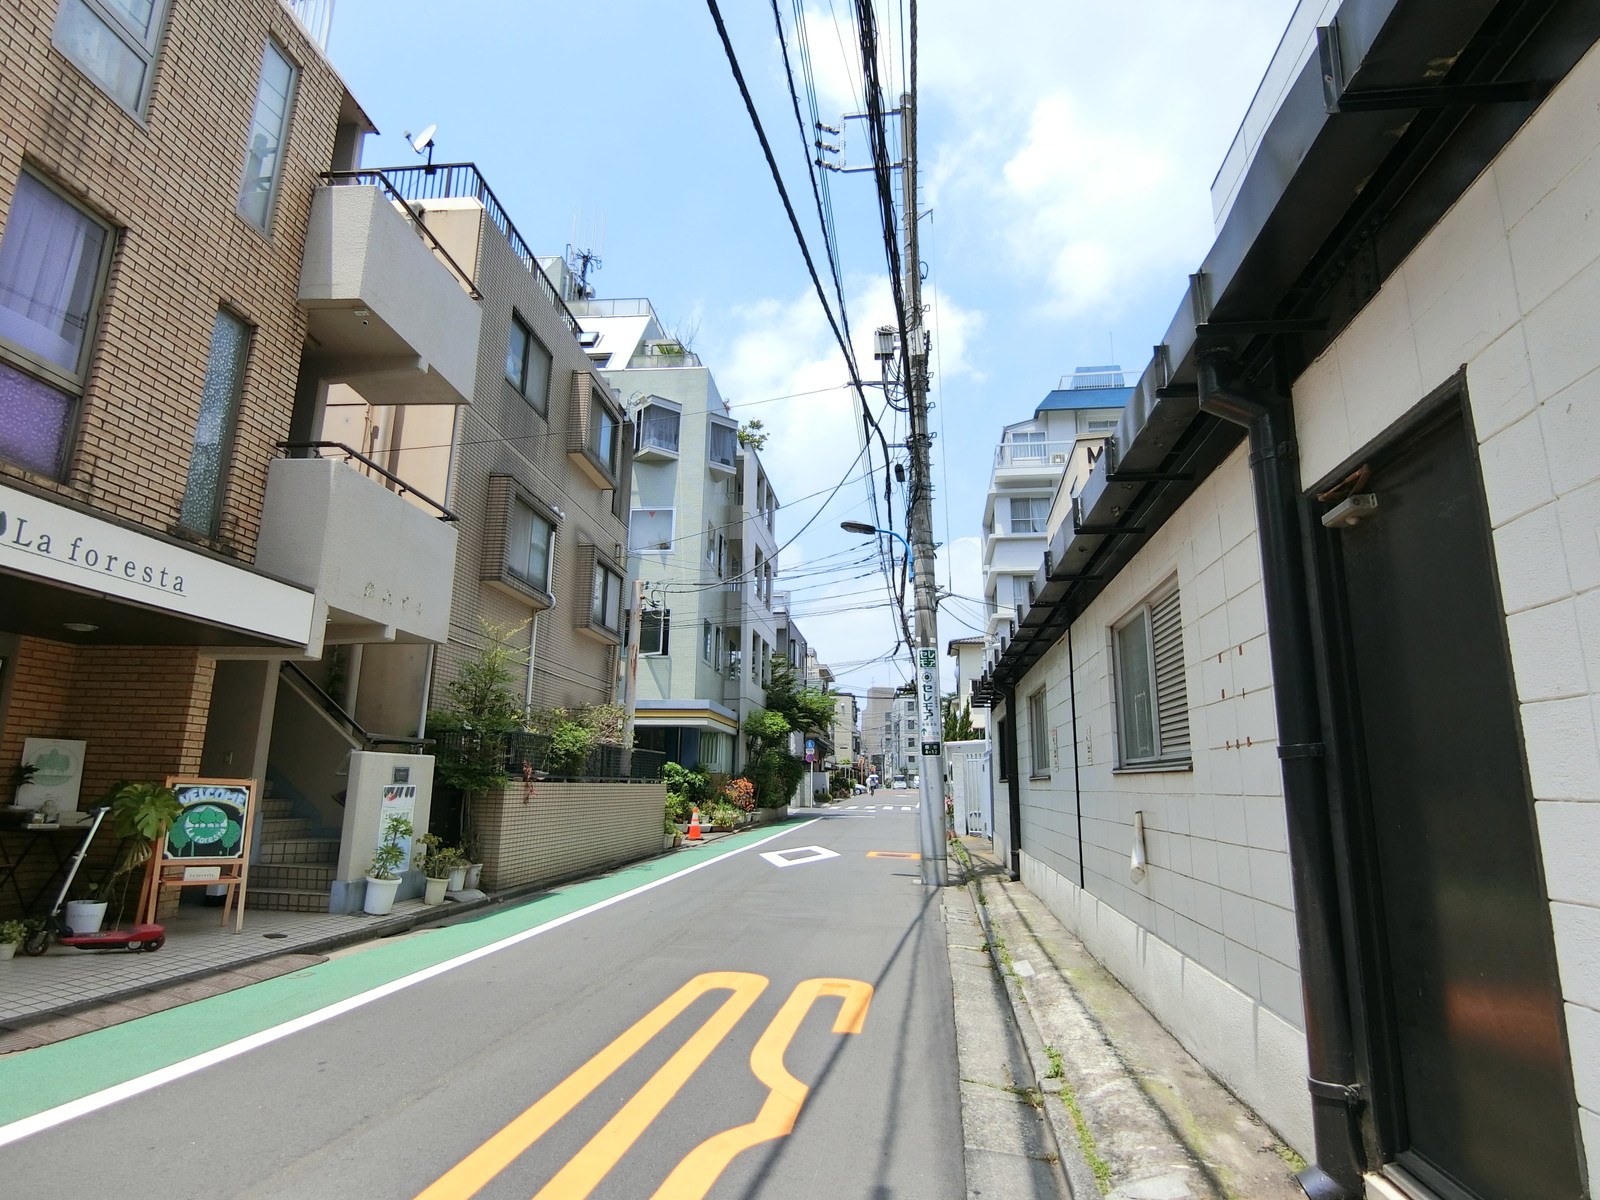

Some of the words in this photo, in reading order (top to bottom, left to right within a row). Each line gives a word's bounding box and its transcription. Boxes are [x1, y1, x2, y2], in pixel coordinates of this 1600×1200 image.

[12, 517, 52, 554] La
[68, 537, 185, 592] foresta
[922, 684, 934, 721] セレモア
[178, 787, 246, 805] WELCOME
